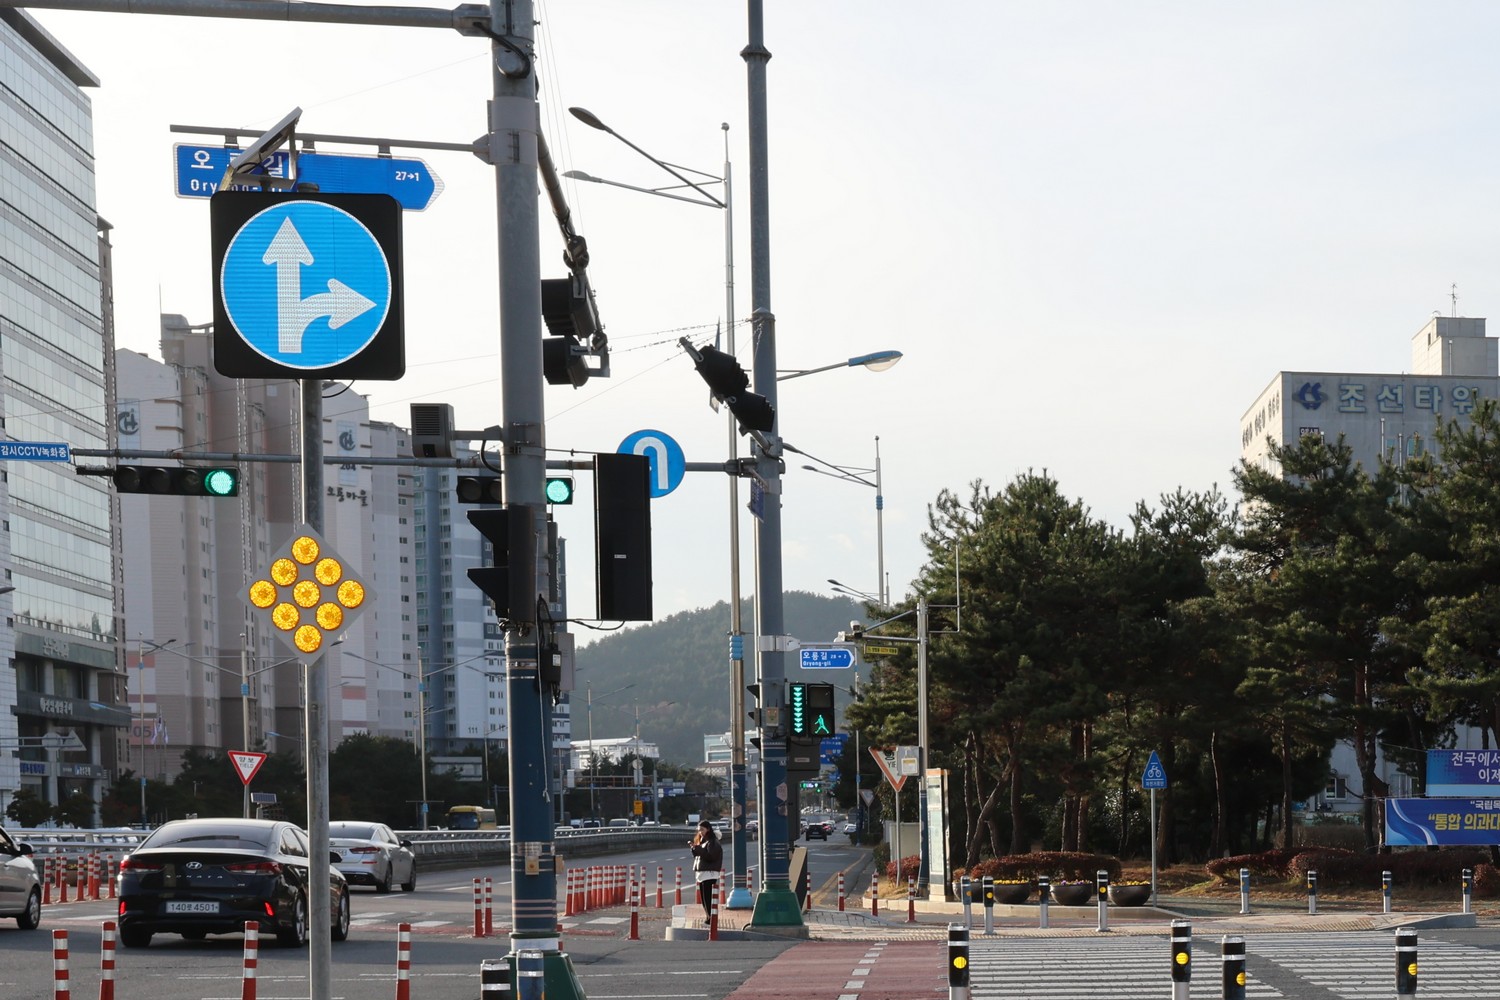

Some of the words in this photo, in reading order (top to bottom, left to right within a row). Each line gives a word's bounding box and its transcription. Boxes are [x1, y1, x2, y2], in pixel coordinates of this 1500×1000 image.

[191, 150, 283, 179] 오길
[803, 651, 828, 661] 오룡길
[194, 904, 215, 912] 4501
